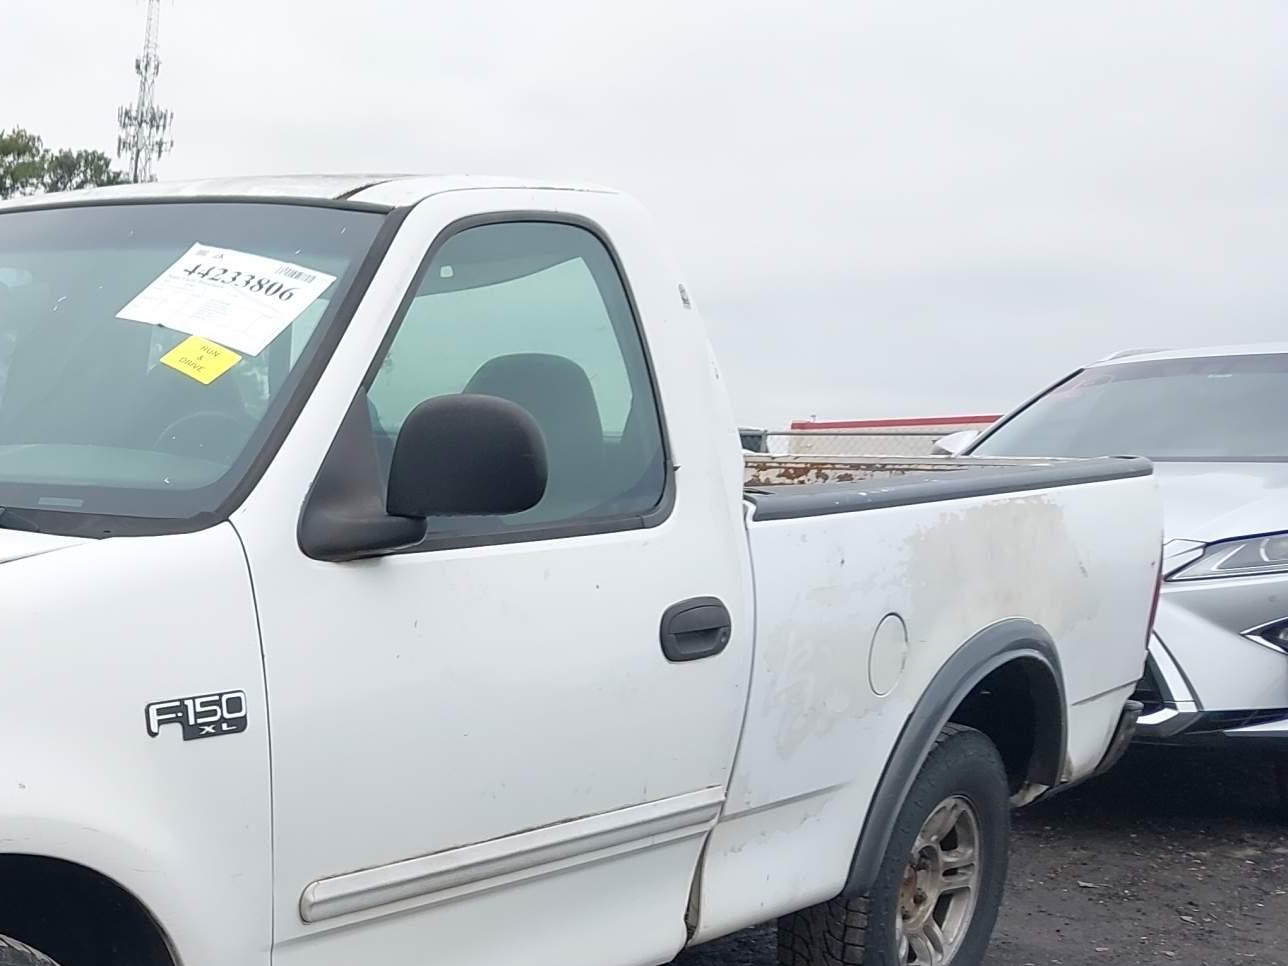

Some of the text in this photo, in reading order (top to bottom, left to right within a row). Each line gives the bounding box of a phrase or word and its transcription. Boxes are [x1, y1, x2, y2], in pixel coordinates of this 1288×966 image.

[183, 263, 297, 301] 44233806
[200, 345, 220, 358] RUN
[179, 356, 206, 373] DRIVE
[198, 722, 238, 735] XL
